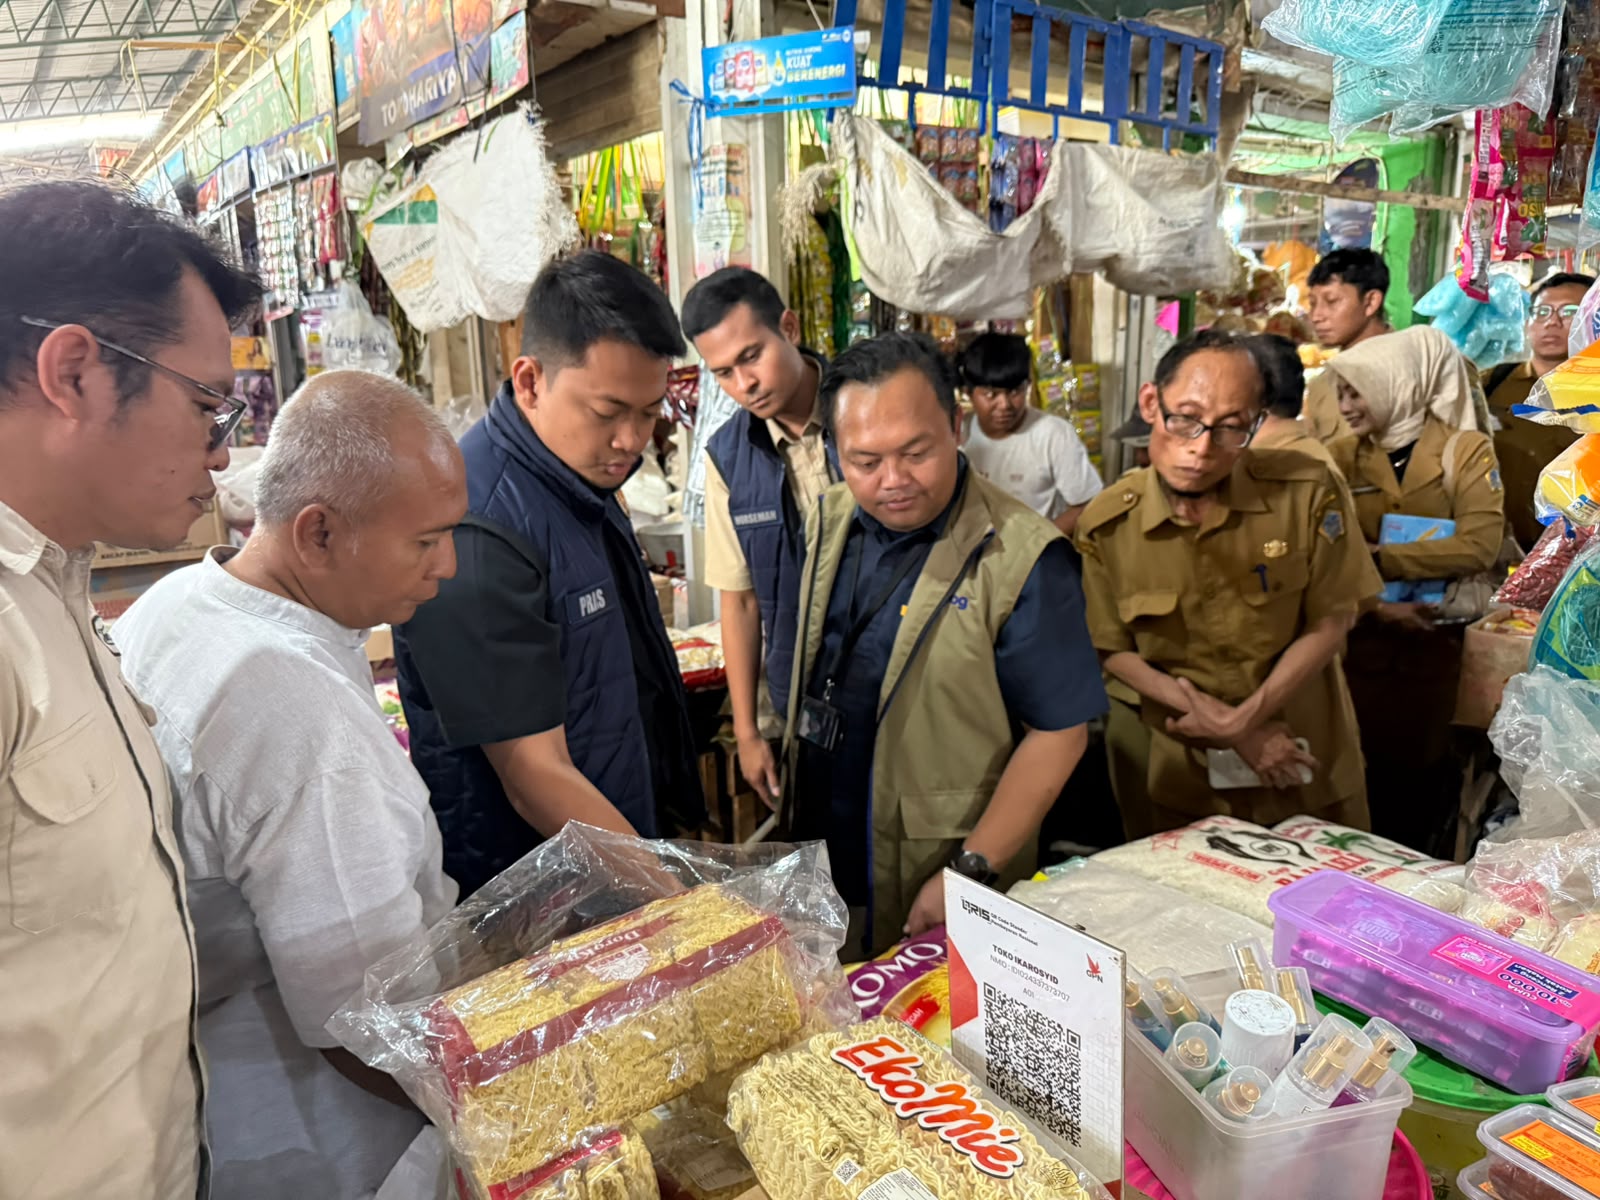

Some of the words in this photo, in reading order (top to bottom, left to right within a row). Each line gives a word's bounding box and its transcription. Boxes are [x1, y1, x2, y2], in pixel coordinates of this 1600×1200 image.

[786, 54, 813, 69] KUAT
[786, 64, 847, 83] BERENERGI
[961, 898, 990, 923] QRIS
[990, 954, 1007, 968] NMID
[992, 944, 1014, 961] TOKO
[1014, 956, 1059, 985] IKAROSYID
[1086, 969, 1104, 984] GPN
[1499, 973, 1559, 1004] 10.000
[1507, 984, 1538, 1001] CUMA
